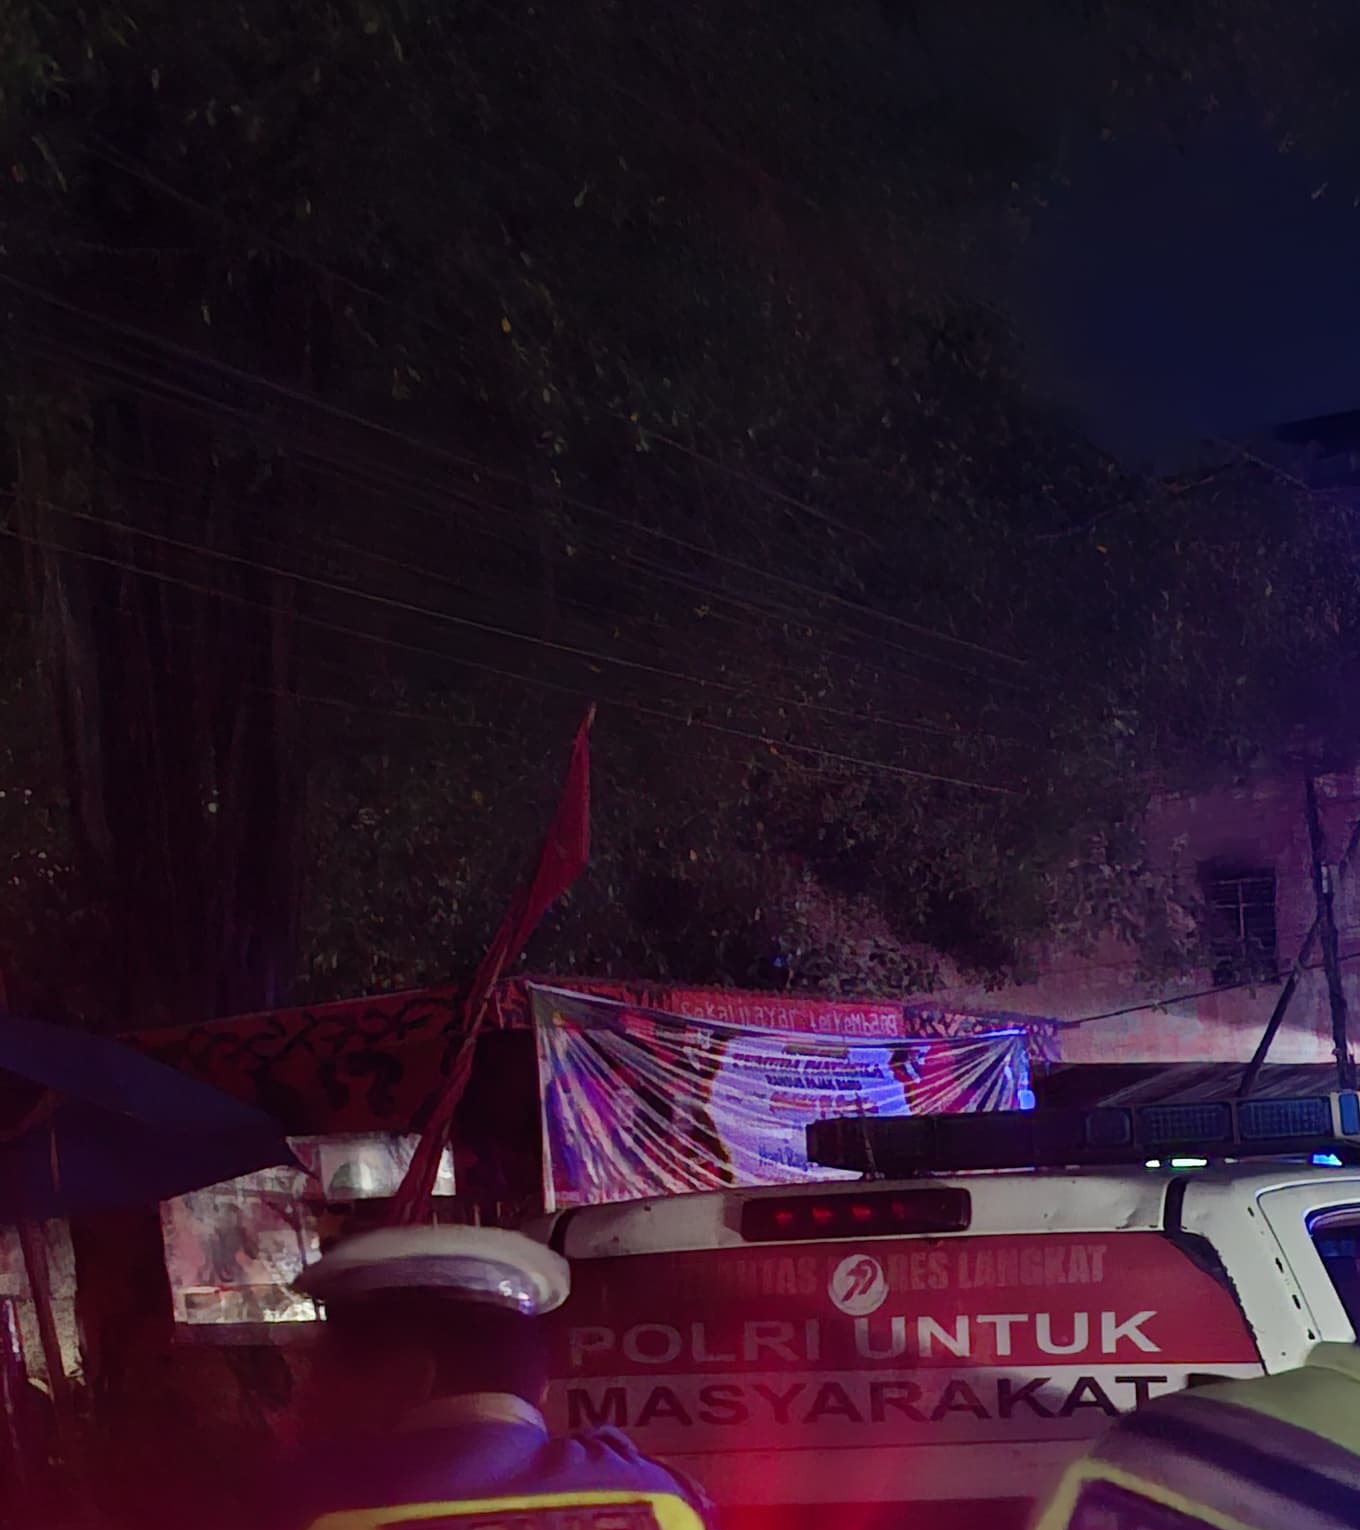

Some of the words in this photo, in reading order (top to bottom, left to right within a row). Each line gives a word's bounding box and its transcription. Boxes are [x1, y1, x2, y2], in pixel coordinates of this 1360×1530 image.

[569, 1319, 821, 1367] POLRI
[853, 1310, 1163, 1360] UNTUK
[566, 1375, 1168, 1429] MASYARAKAT
